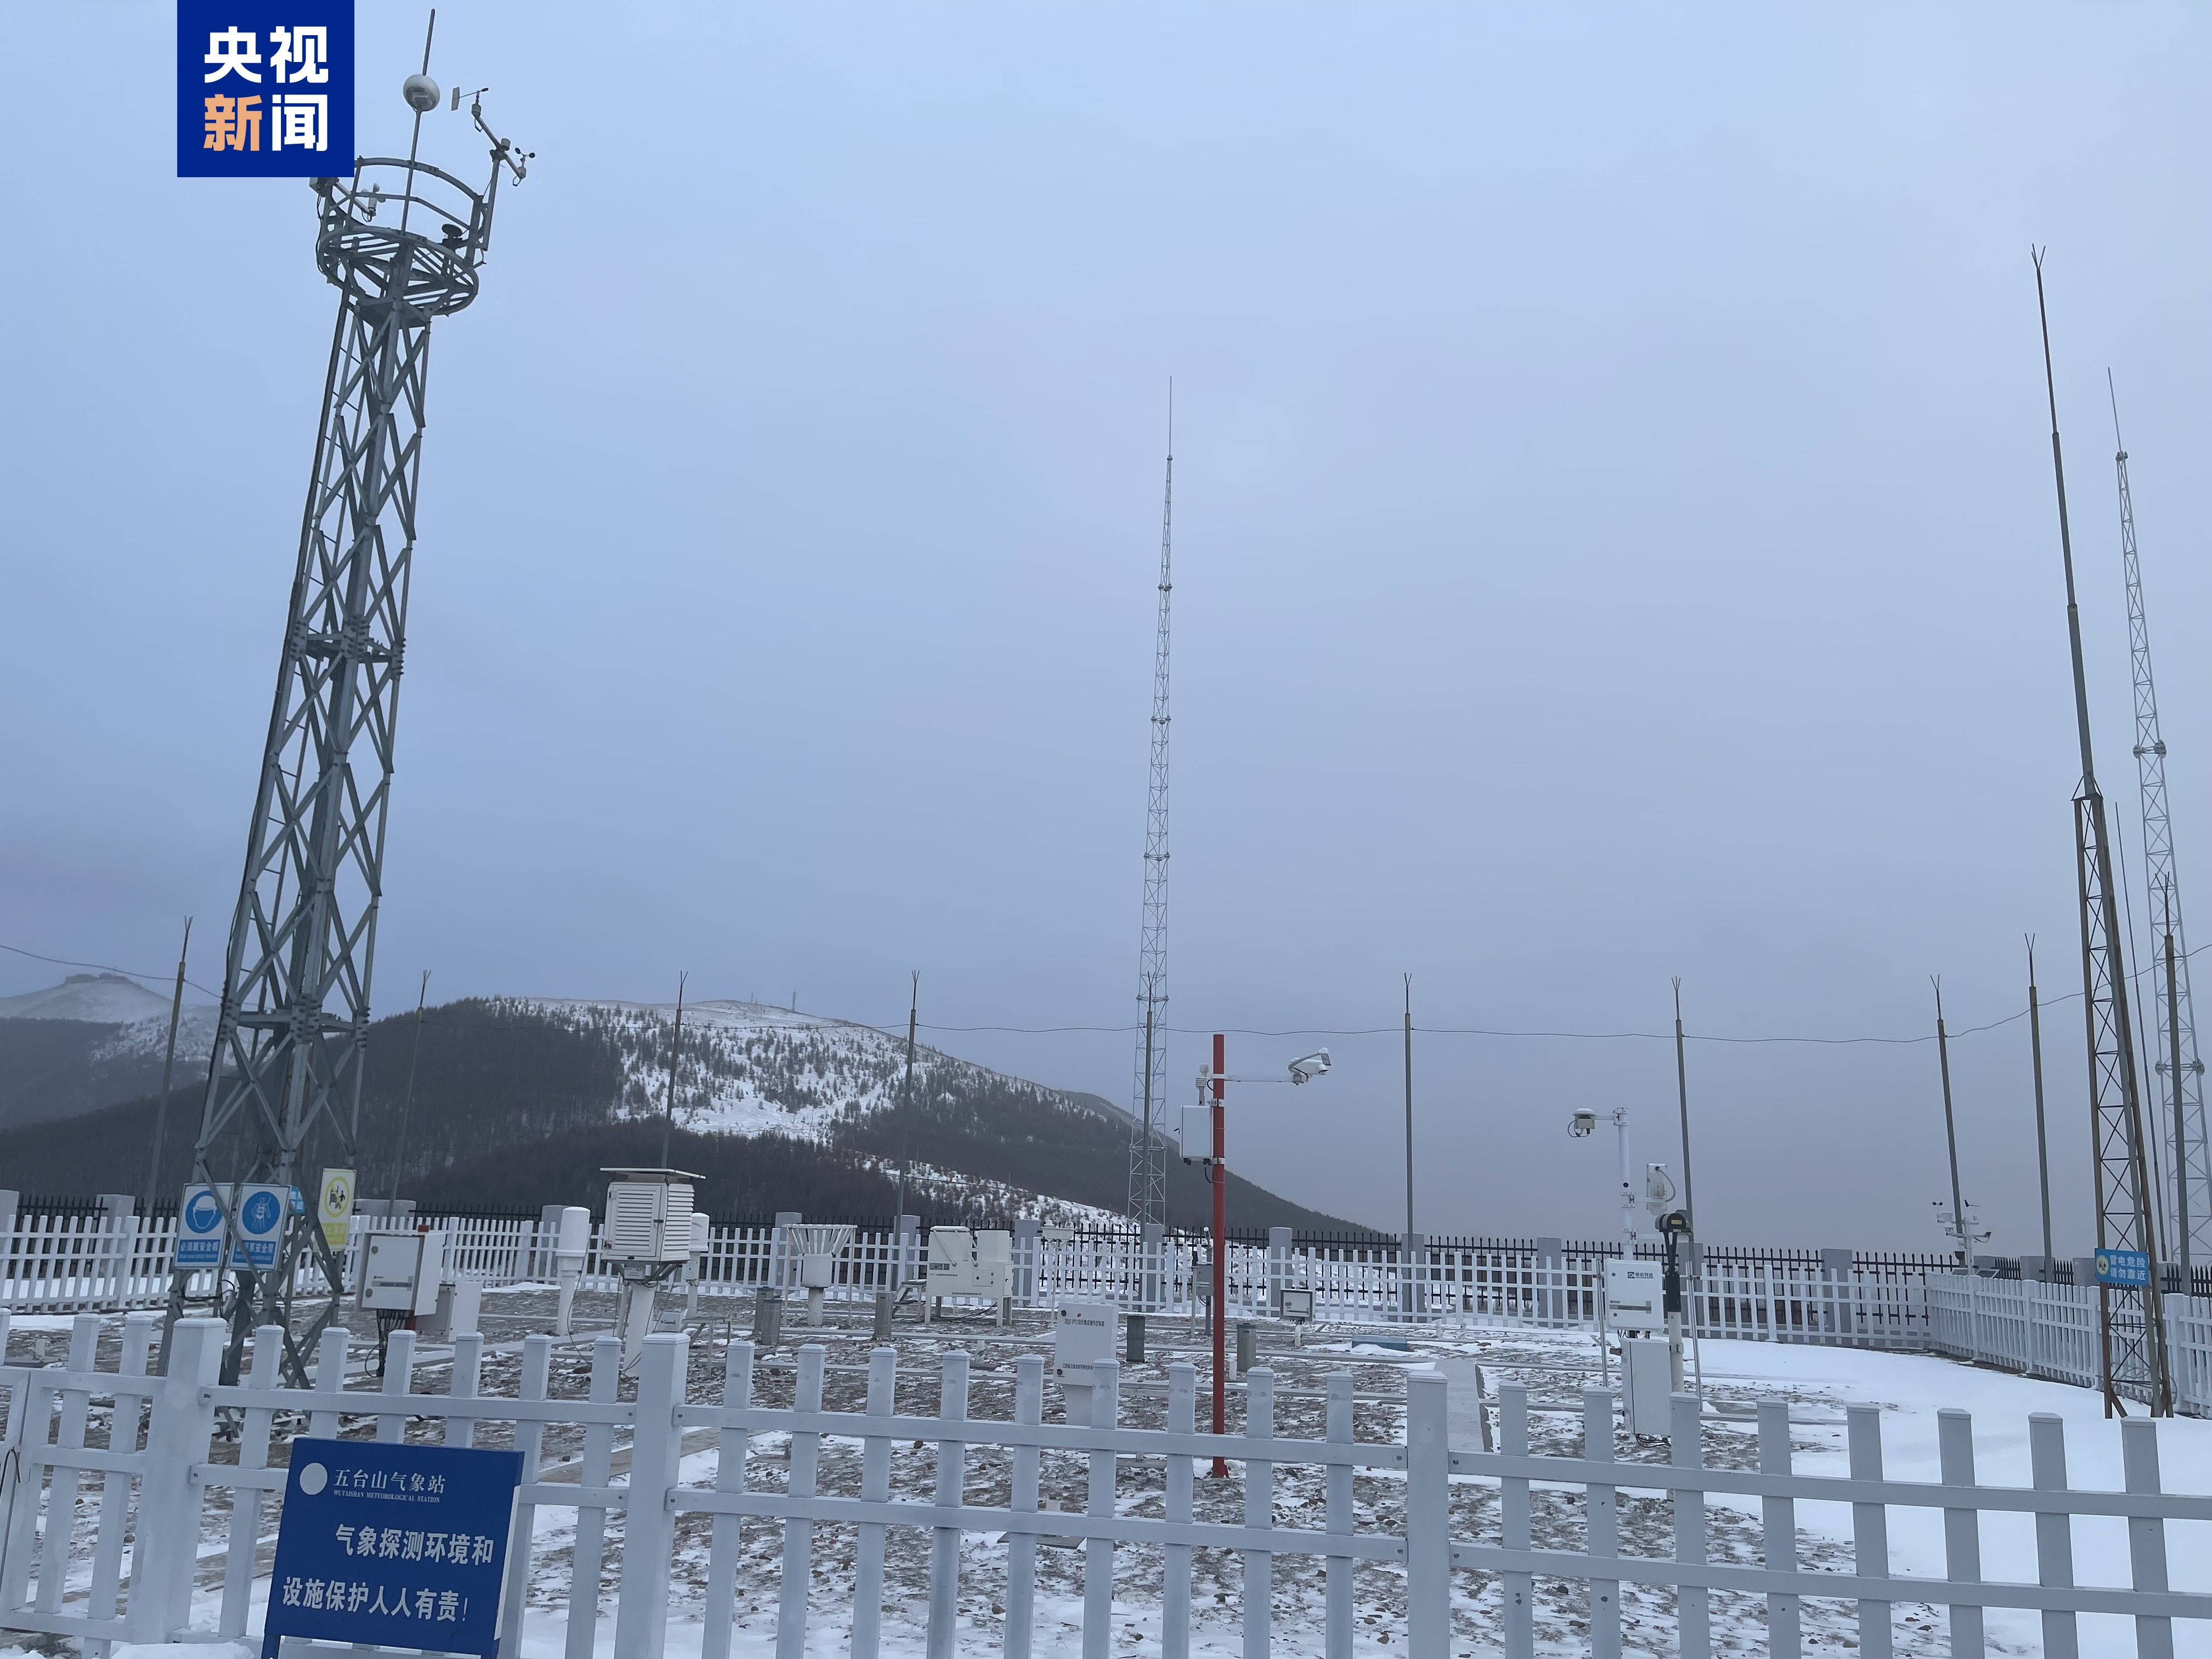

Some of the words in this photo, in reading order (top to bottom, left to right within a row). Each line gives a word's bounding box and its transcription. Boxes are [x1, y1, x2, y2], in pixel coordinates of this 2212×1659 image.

[2110, 1255, 2146, 1268] 雷电危险
[2110, 1267, 2146, 1281] 请勿靠近
[333, 1469, 446, 1494] 五台山气象站
[334, 1489, 364, 1498] WUTAISHAN
[366, 1492, 415, 1502] METEOROLOGICAL
[335, 1523, 494, 1566] 气象探测环境和
